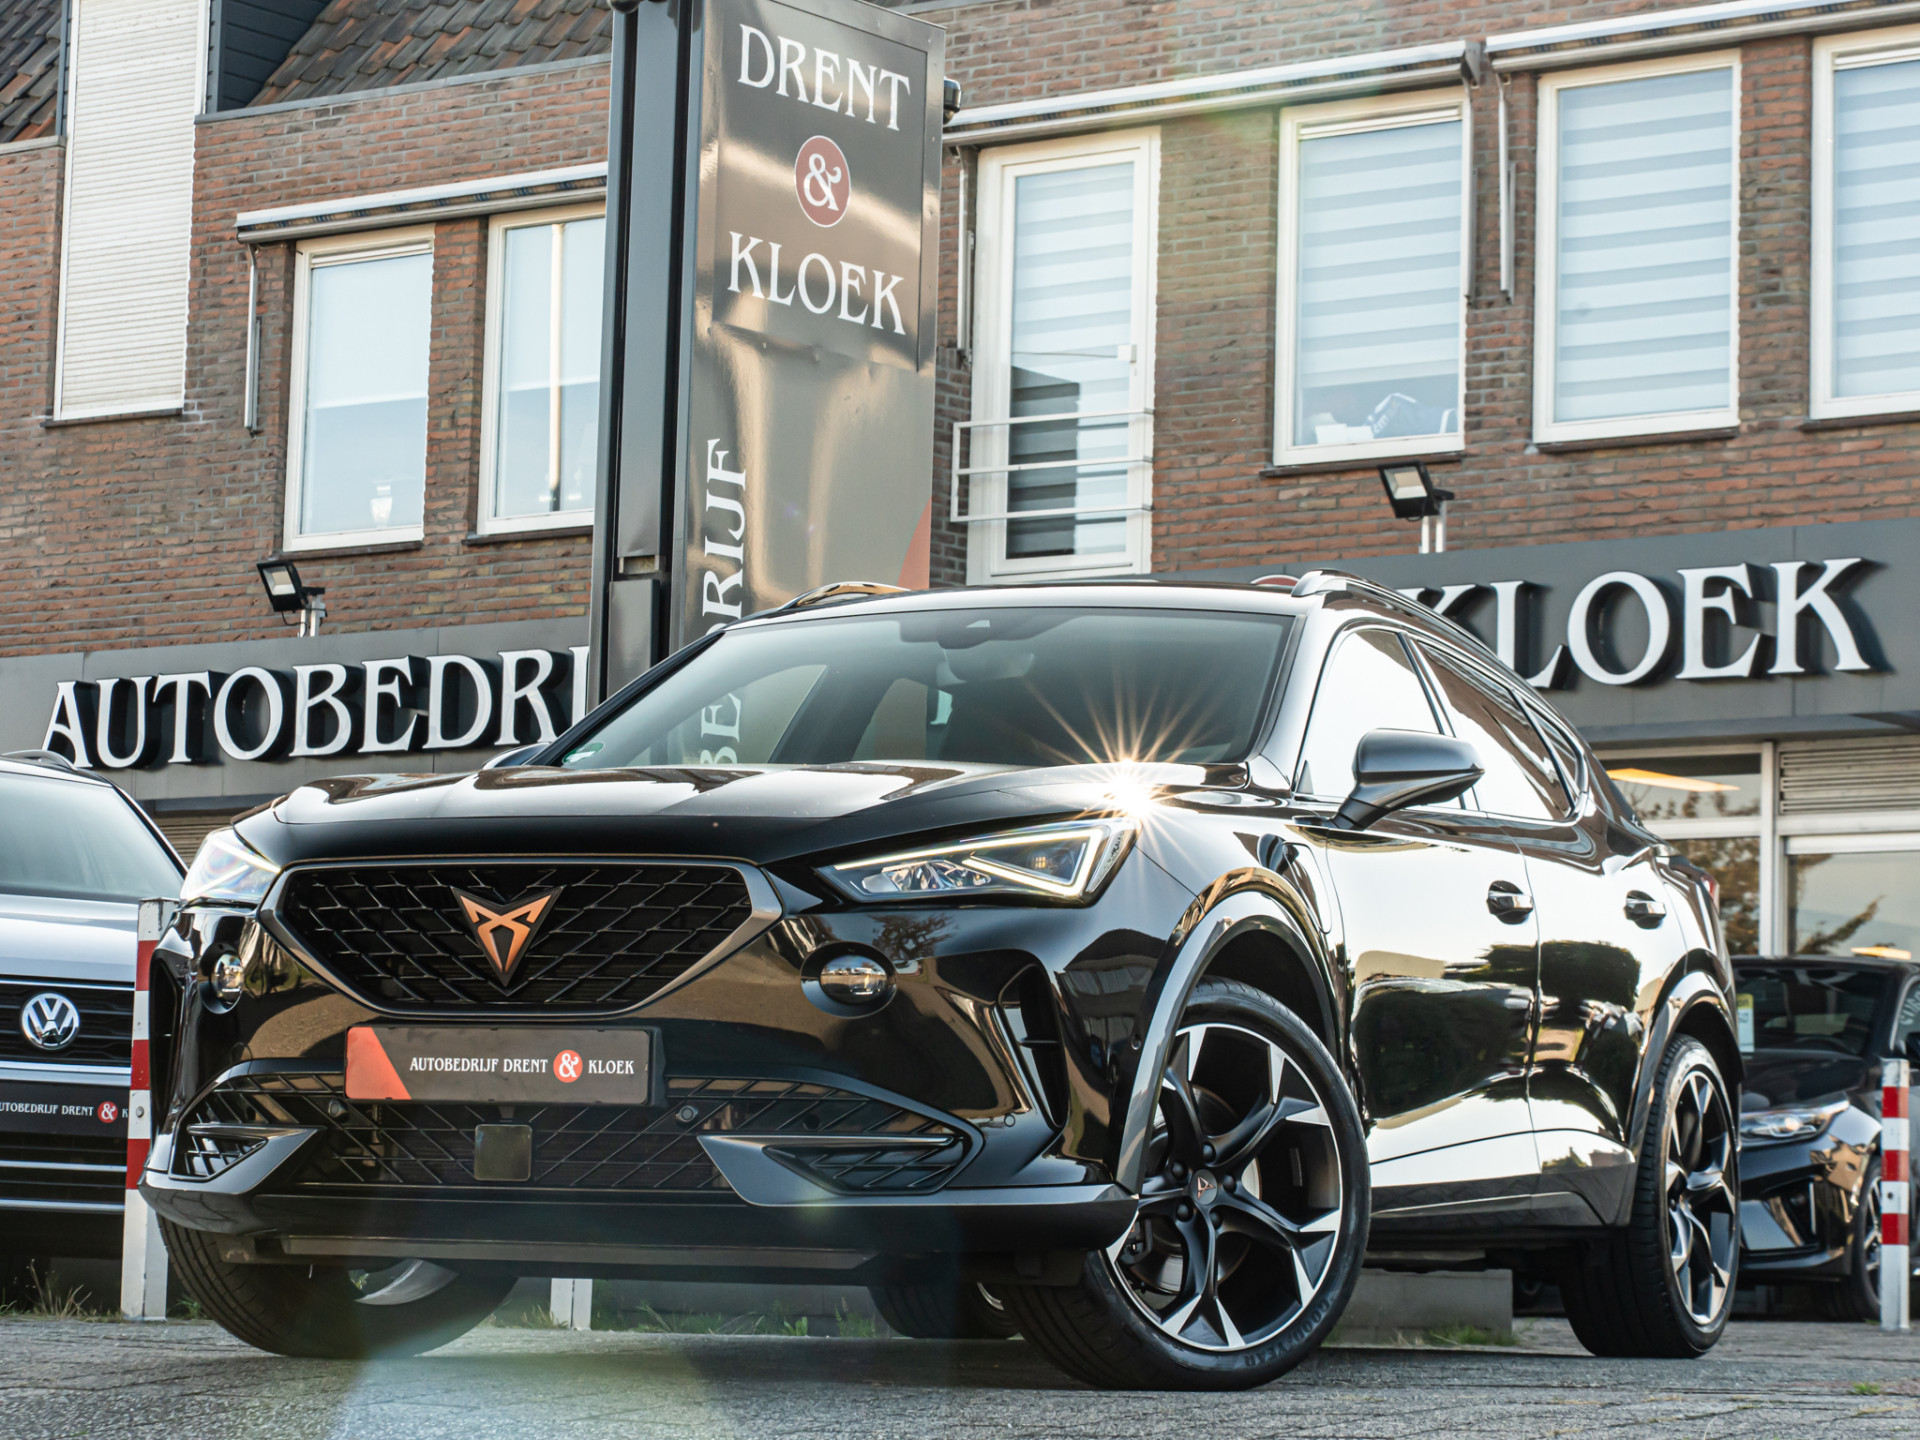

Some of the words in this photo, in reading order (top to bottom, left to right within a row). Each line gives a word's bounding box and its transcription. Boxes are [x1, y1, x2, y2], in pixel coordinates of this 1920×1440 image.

[738, 24, 910, 131] DRENT
[803, 153, 841, 211] &
[727, 231, 906, 335] KLOEK
[409, 1057, 499, 1072] AUTOBEDRIJF
[503, 1058, 548, 1073] DRENT
[558, 1052, 579, 1078] &
[588, 1060, 635, 1075] KLOEK
[61, 1105, 94, 1116] DRENT
[101, 1103, 116, 1120] &
